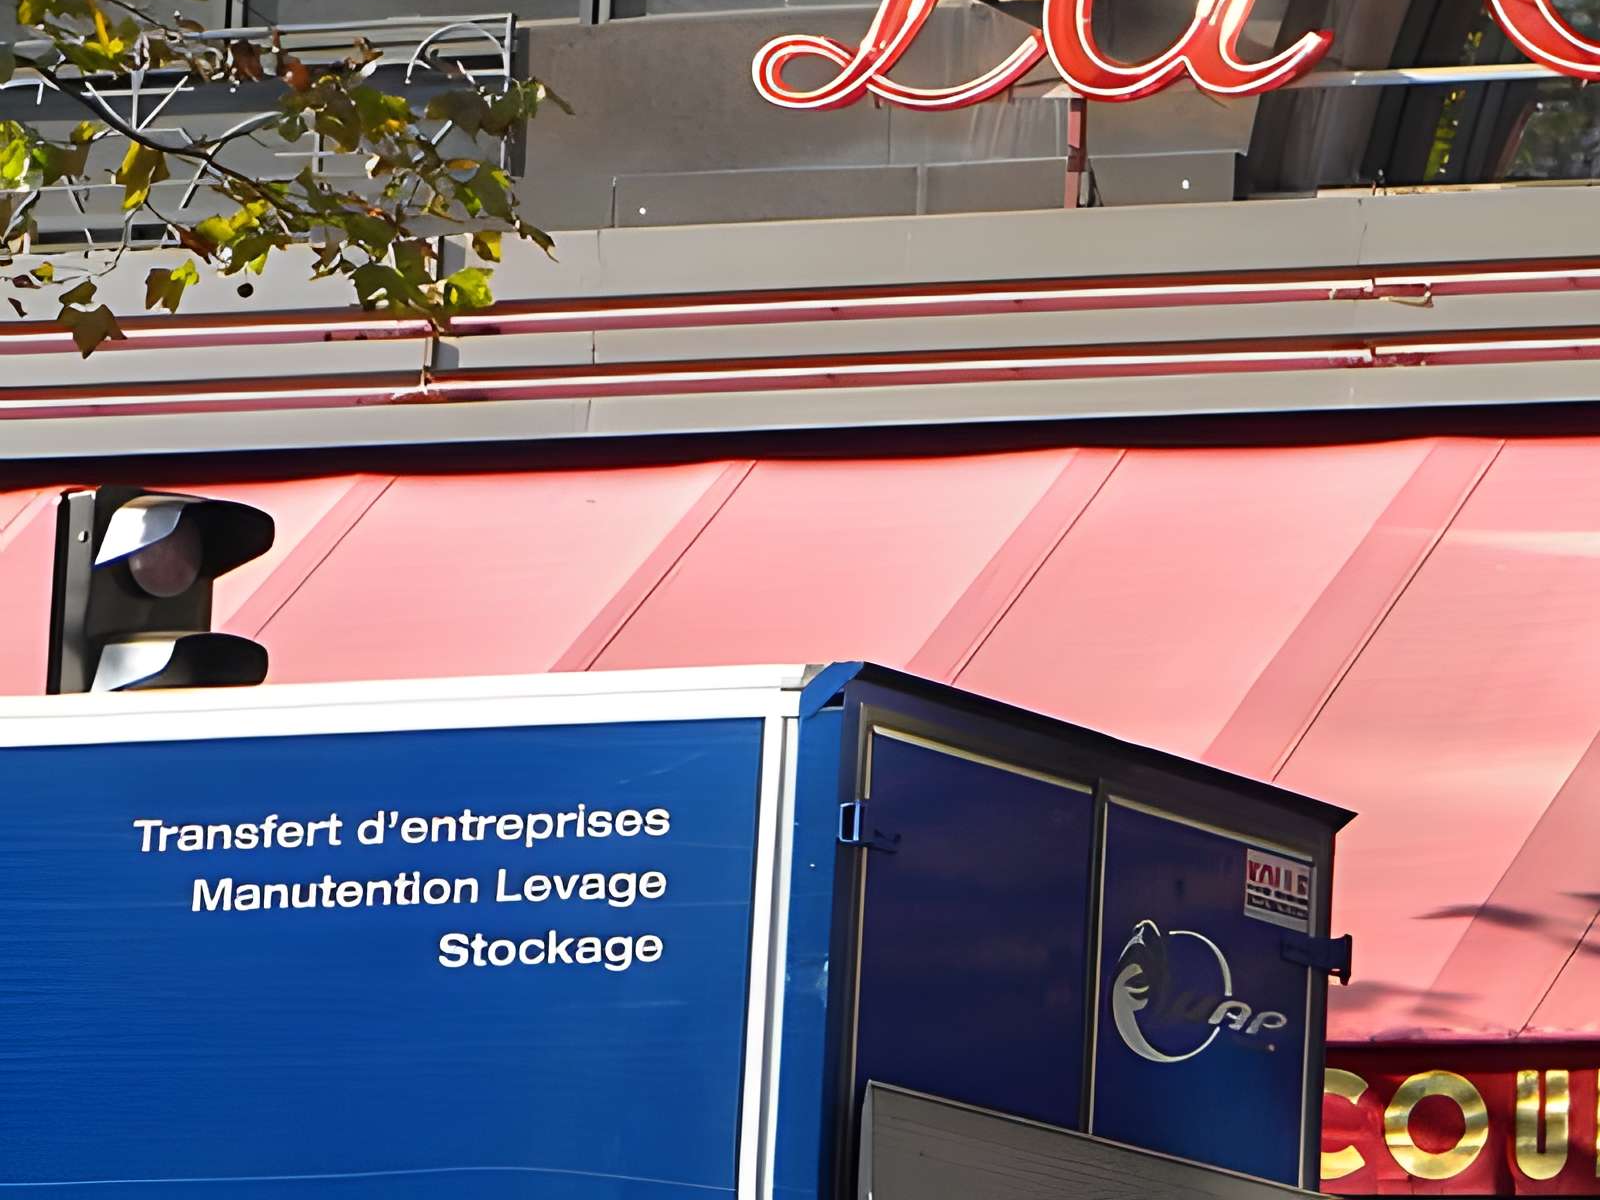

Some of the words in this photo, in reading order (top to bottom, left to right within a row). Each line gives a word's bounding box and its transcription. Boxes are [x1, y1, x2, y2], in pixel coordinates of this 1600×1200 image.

[133, 813, 343, 852] Transfert
[357, 803, 671, 848] d'entreprises
[191, 870, 479, 912] Manutention
[496, 867, 667, 908] Levage
[438, 929, 664, 971] Stockage
